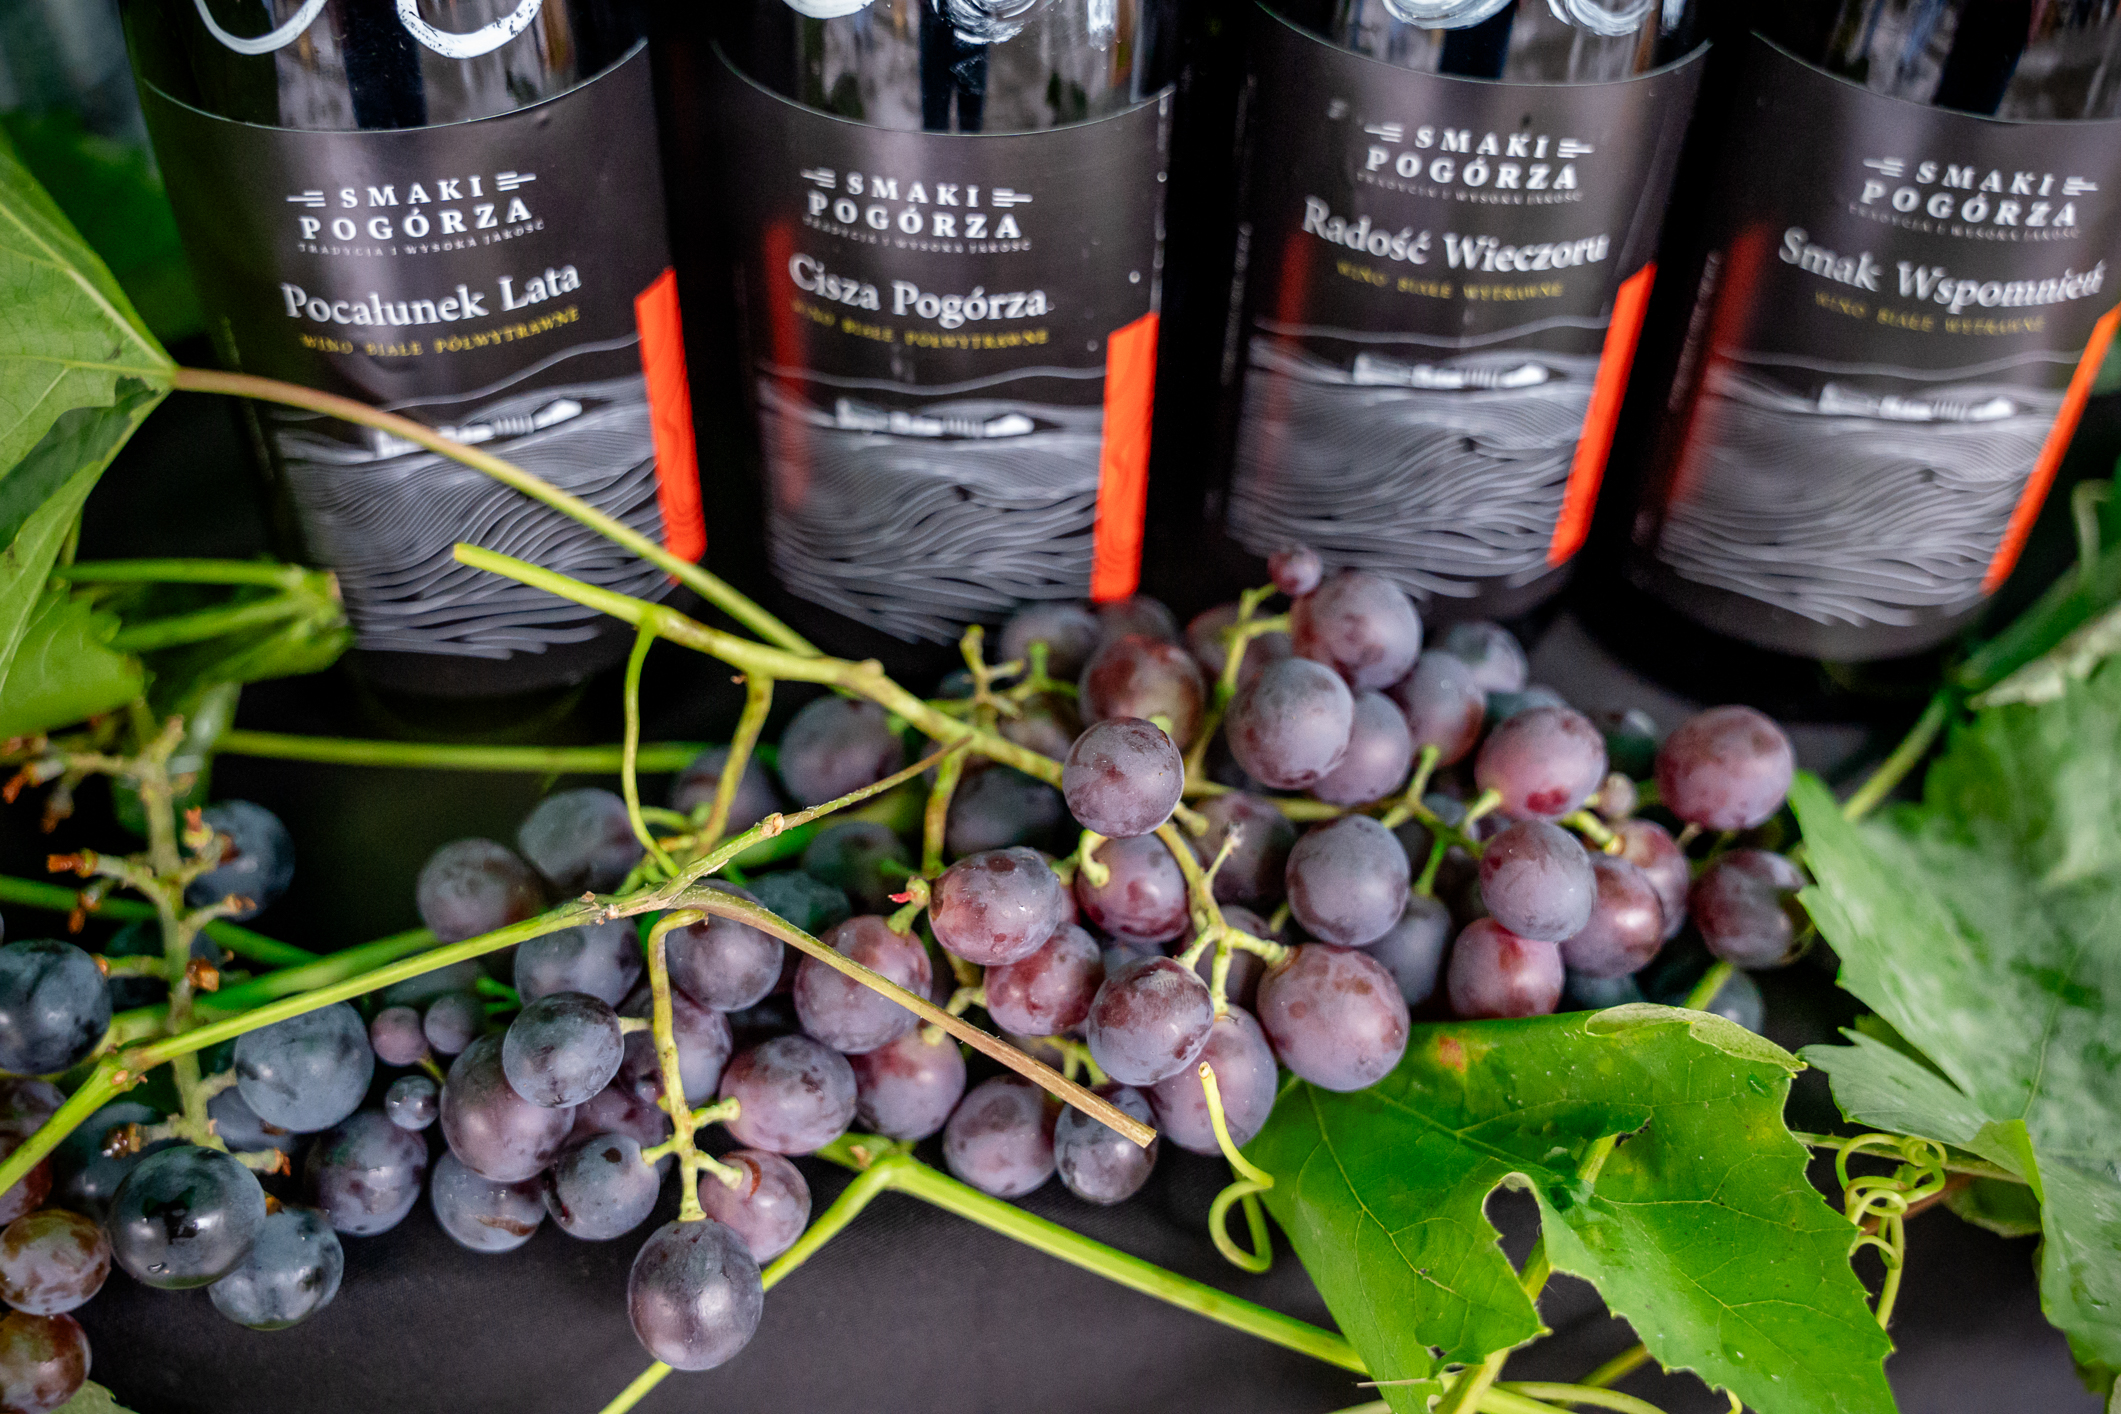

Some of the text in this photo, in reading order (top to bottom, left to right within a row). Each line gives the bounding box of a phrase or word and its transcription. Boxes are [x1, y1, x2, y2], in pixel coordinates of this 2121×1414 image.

[1414, 124, 1550, 159] SMAKI
[846, 171, 979, 208] SMAKI
[1366, 144, 1578, 190] POGÓRZA
[1916, 160, 2055, 197] SMAKI
[340, 174, 484, 209] SMAKI
[808, 189, 1021, 239] POGÓRZA
[1860, 177, 2077, 227] POGÓRZA
[300, 196, 532, 241] POGÓRZA
[1302, 195, 1610, 272] Radość Wieczoru
[404, 236, 478, 255] WYSOKA
[1779, 226, 1884, 292] Smak
[281, 264, 582, 326] Pocałunek Lata
[788, 252, 1048, 329] Cisza Pogórza
[300, 333, 354, 355] WINO
